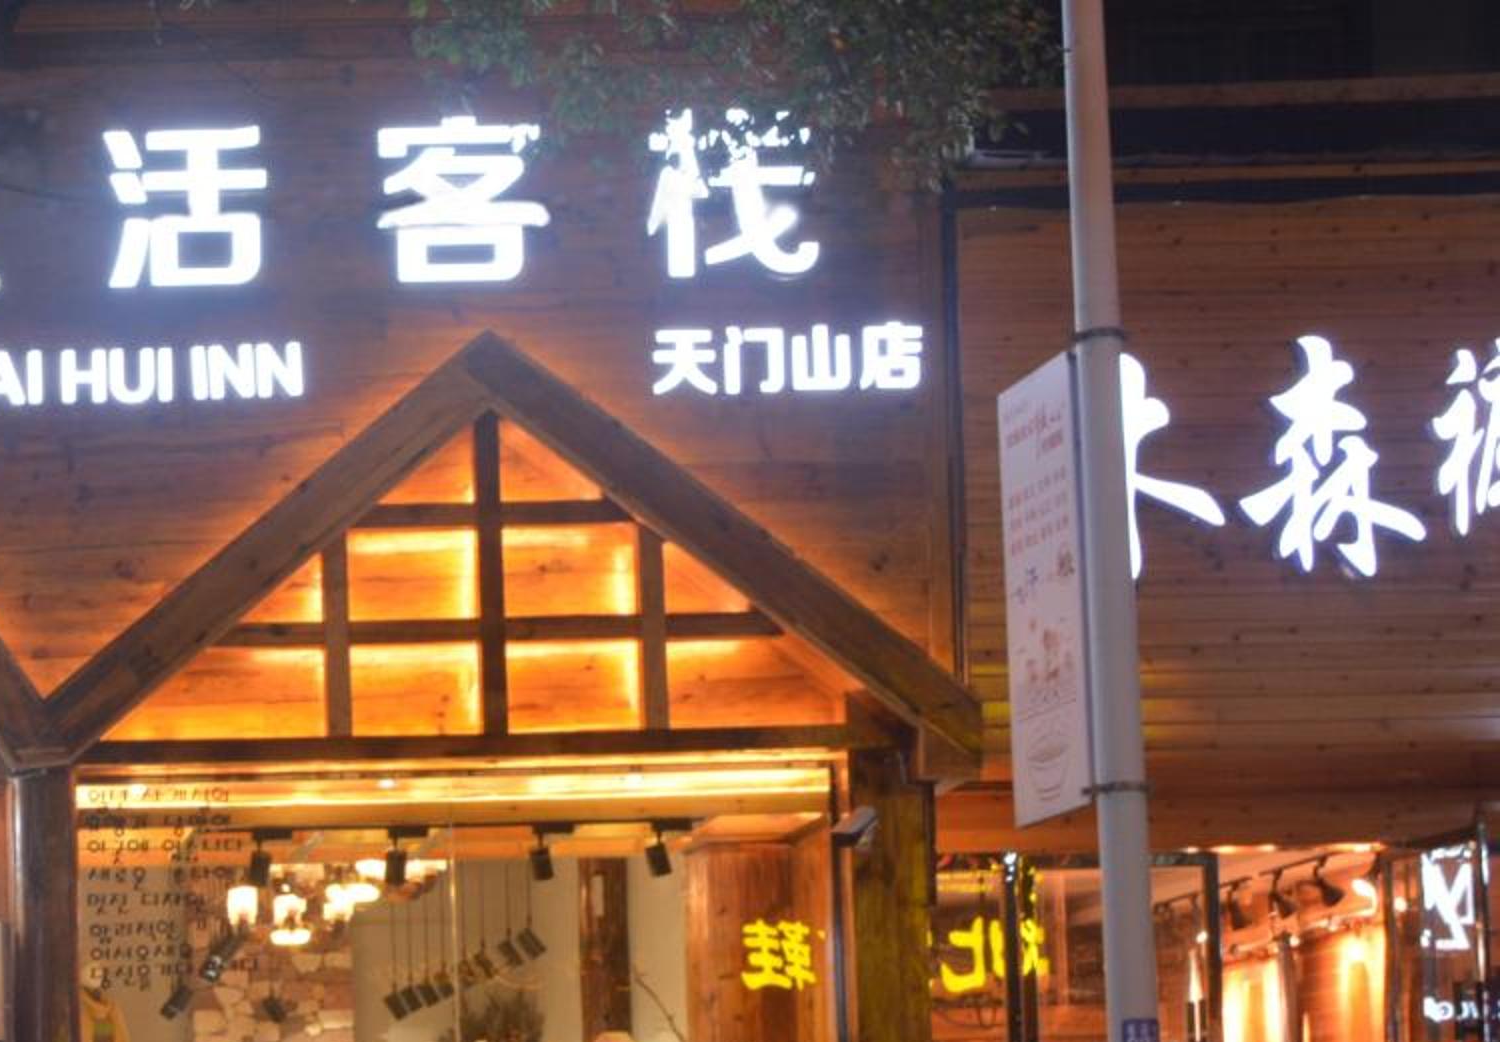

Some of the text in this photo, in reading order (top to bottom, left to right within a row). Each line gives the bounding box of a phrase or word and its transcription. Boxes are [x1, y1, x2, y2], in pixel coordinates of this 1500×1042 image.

[60, 347, 174, 405] HUI
[190, 341, 304, 402] INN
[652, 321, 923, 395] 天门山店
